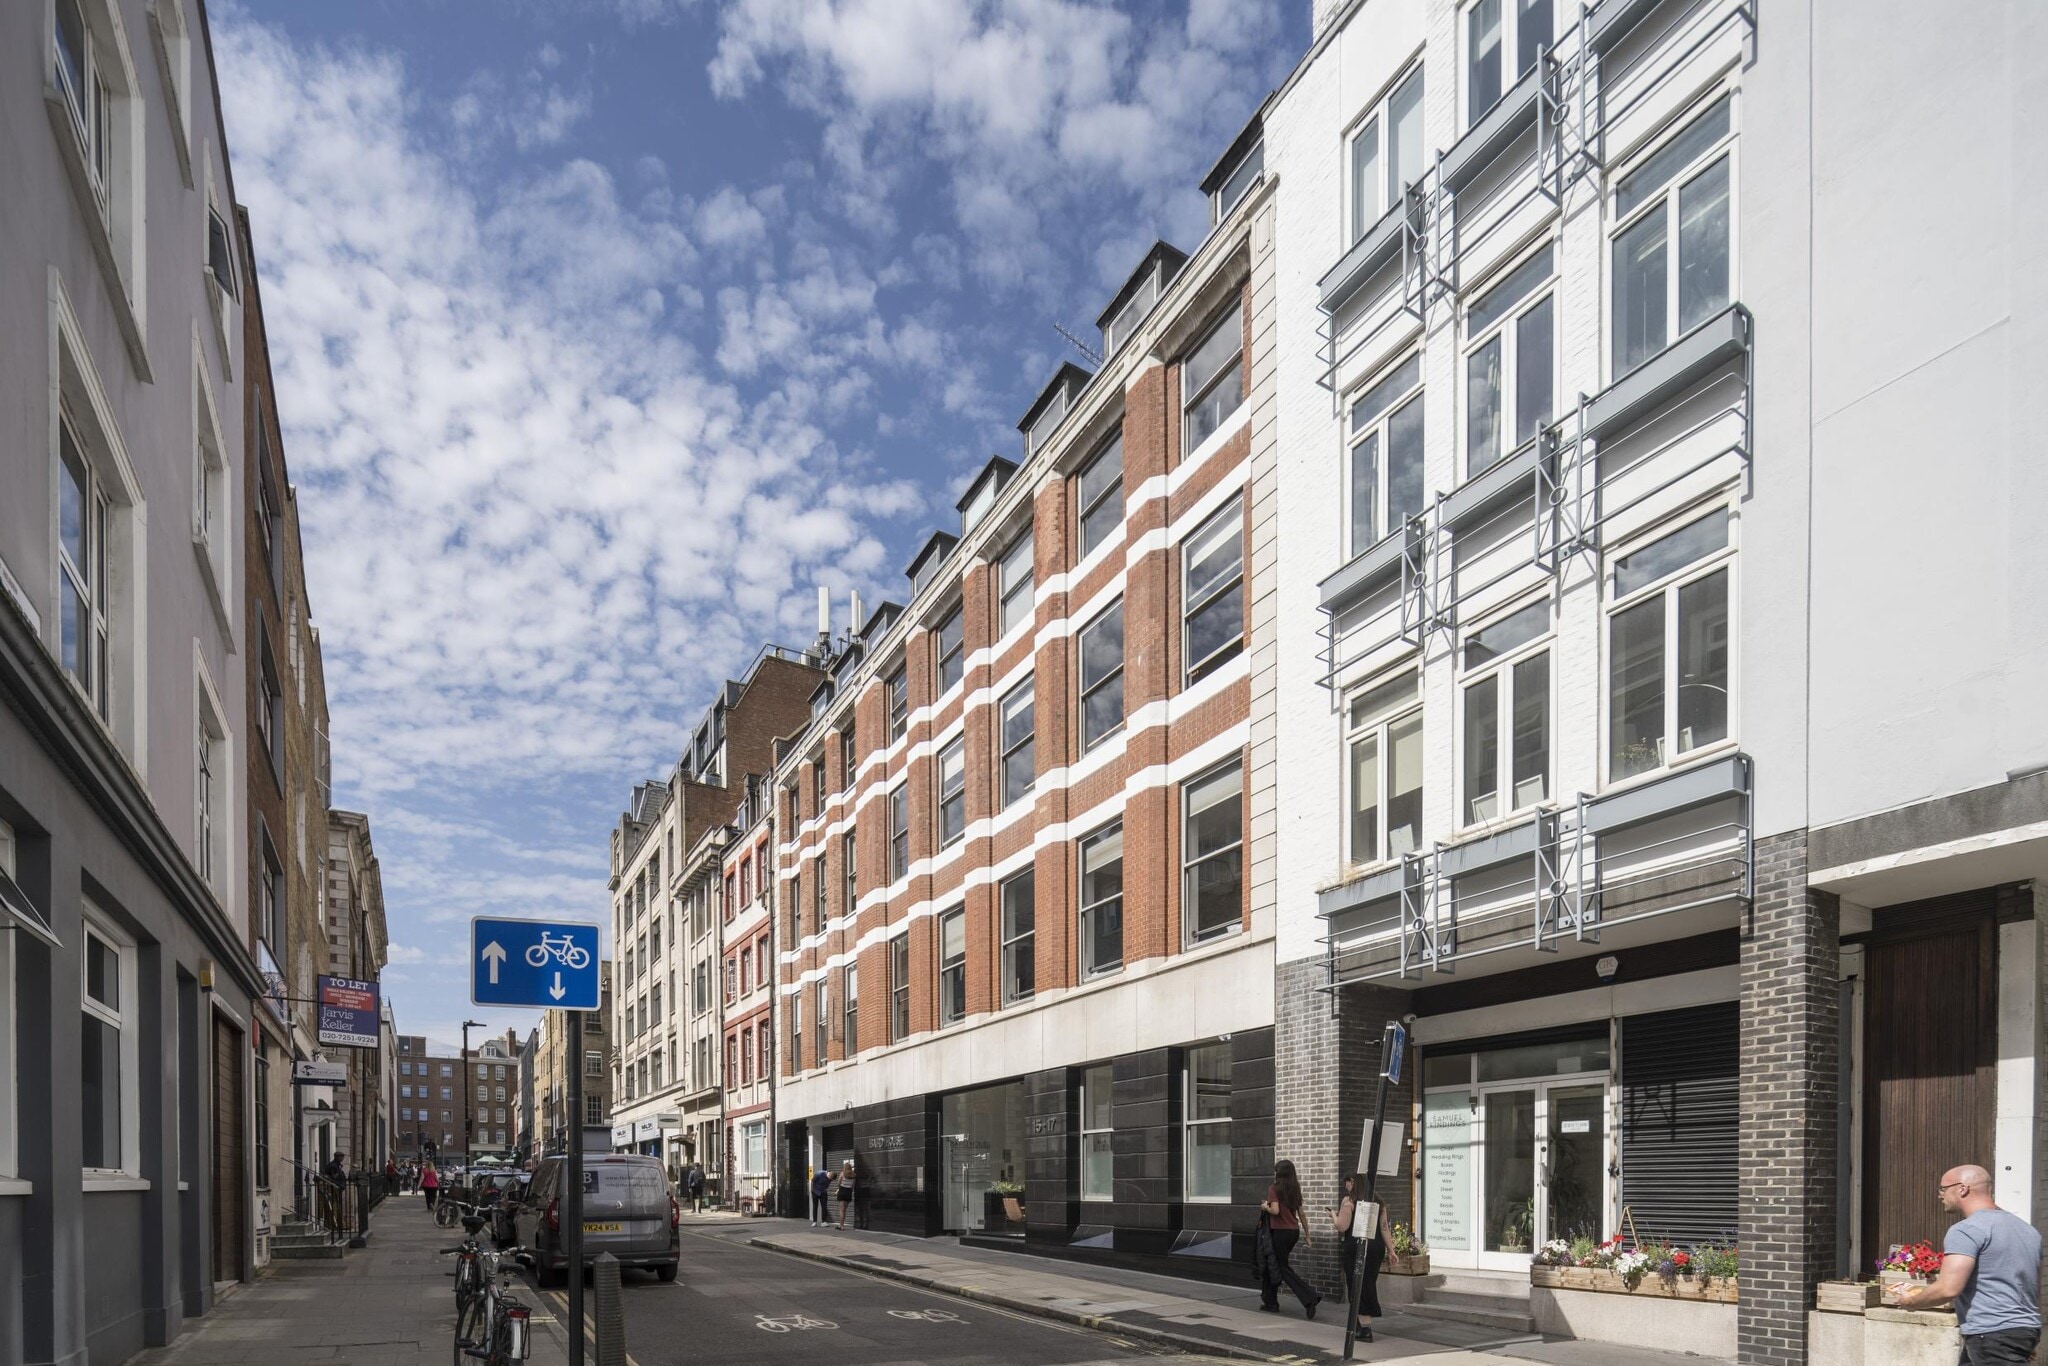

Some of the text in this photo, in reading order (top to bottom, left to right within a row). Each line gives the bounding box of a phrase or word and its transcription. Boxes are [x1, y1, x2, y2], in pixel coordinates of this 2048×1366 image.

[330, 978, 368, 991] TO LET
[322, 1007, 354, 1019] Jarvis
[322, 1019, 354, 1031] Keller
[322, 1032, 375, 1043] 020-7251-9226
[1432, 1114, 1462, 1122] SAMUEL
